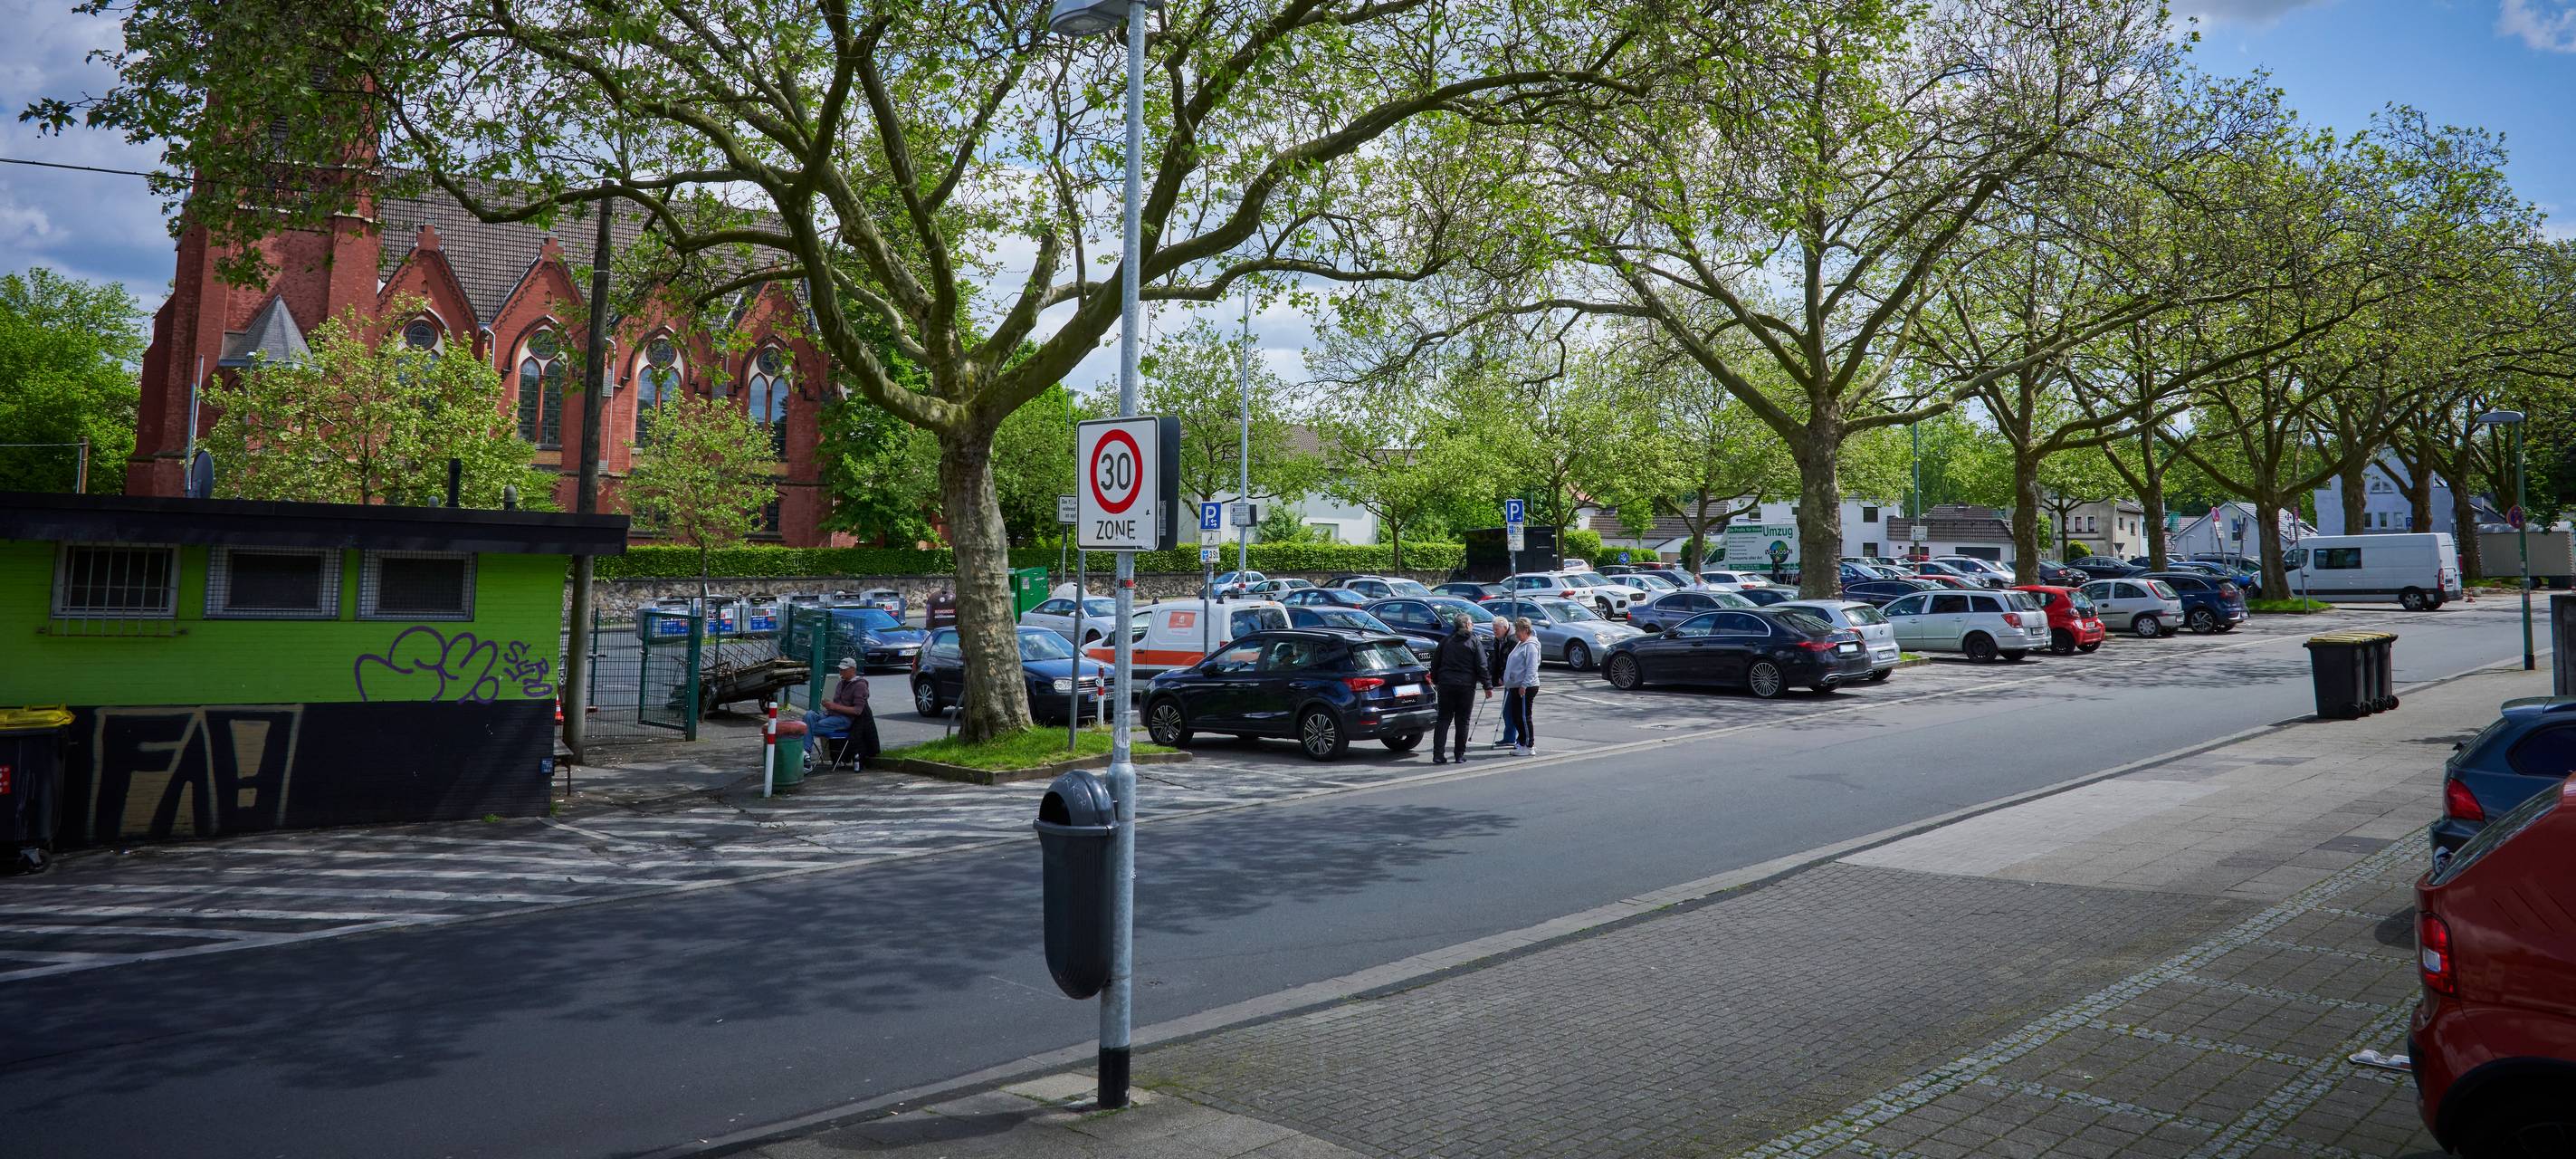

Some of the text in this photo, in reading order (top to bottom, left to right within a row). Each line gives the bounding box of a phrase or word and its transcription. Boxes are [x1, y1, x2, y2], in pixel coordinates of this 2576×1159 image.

[1101, 453, 1131, 490] 30
[1205, 505, 1216, 526] P
[1511, 503, 1520, 521] P
[1096, 520, 1136, 541] ZONE
[1763, 526, 1793, 539] Umzug
